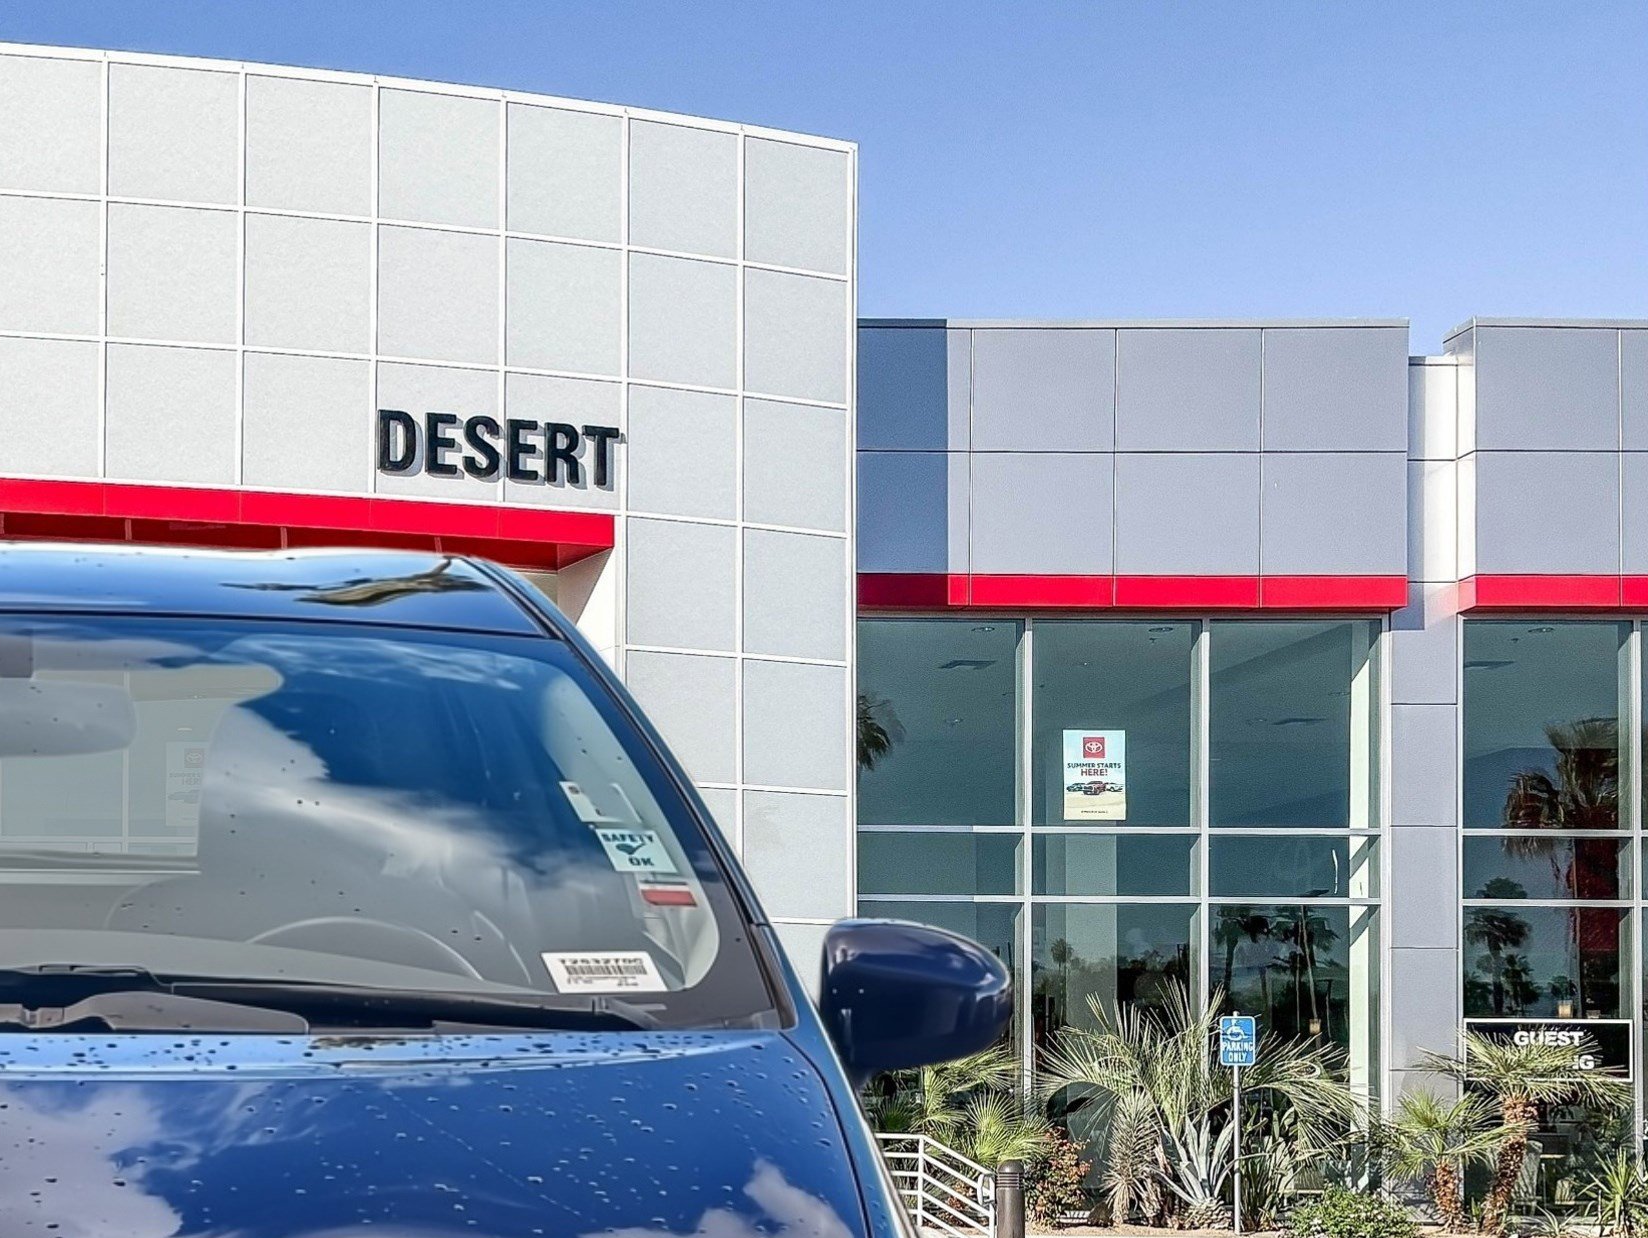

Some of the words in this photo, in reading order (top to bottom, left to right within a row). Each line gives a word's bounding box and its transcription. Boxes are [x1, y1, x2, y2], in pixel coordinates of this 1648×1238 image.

[377, 409, 620, 487] DESERT
[601, 833, 654, 843] SAFETY
[628, 857, 654, 866] OK
[1513, 1030, 1585, 1047] GUEST
[1222, 1041, 1253, 1051] PARKING
[1228, 1052, 1248, 1062] ONLY
